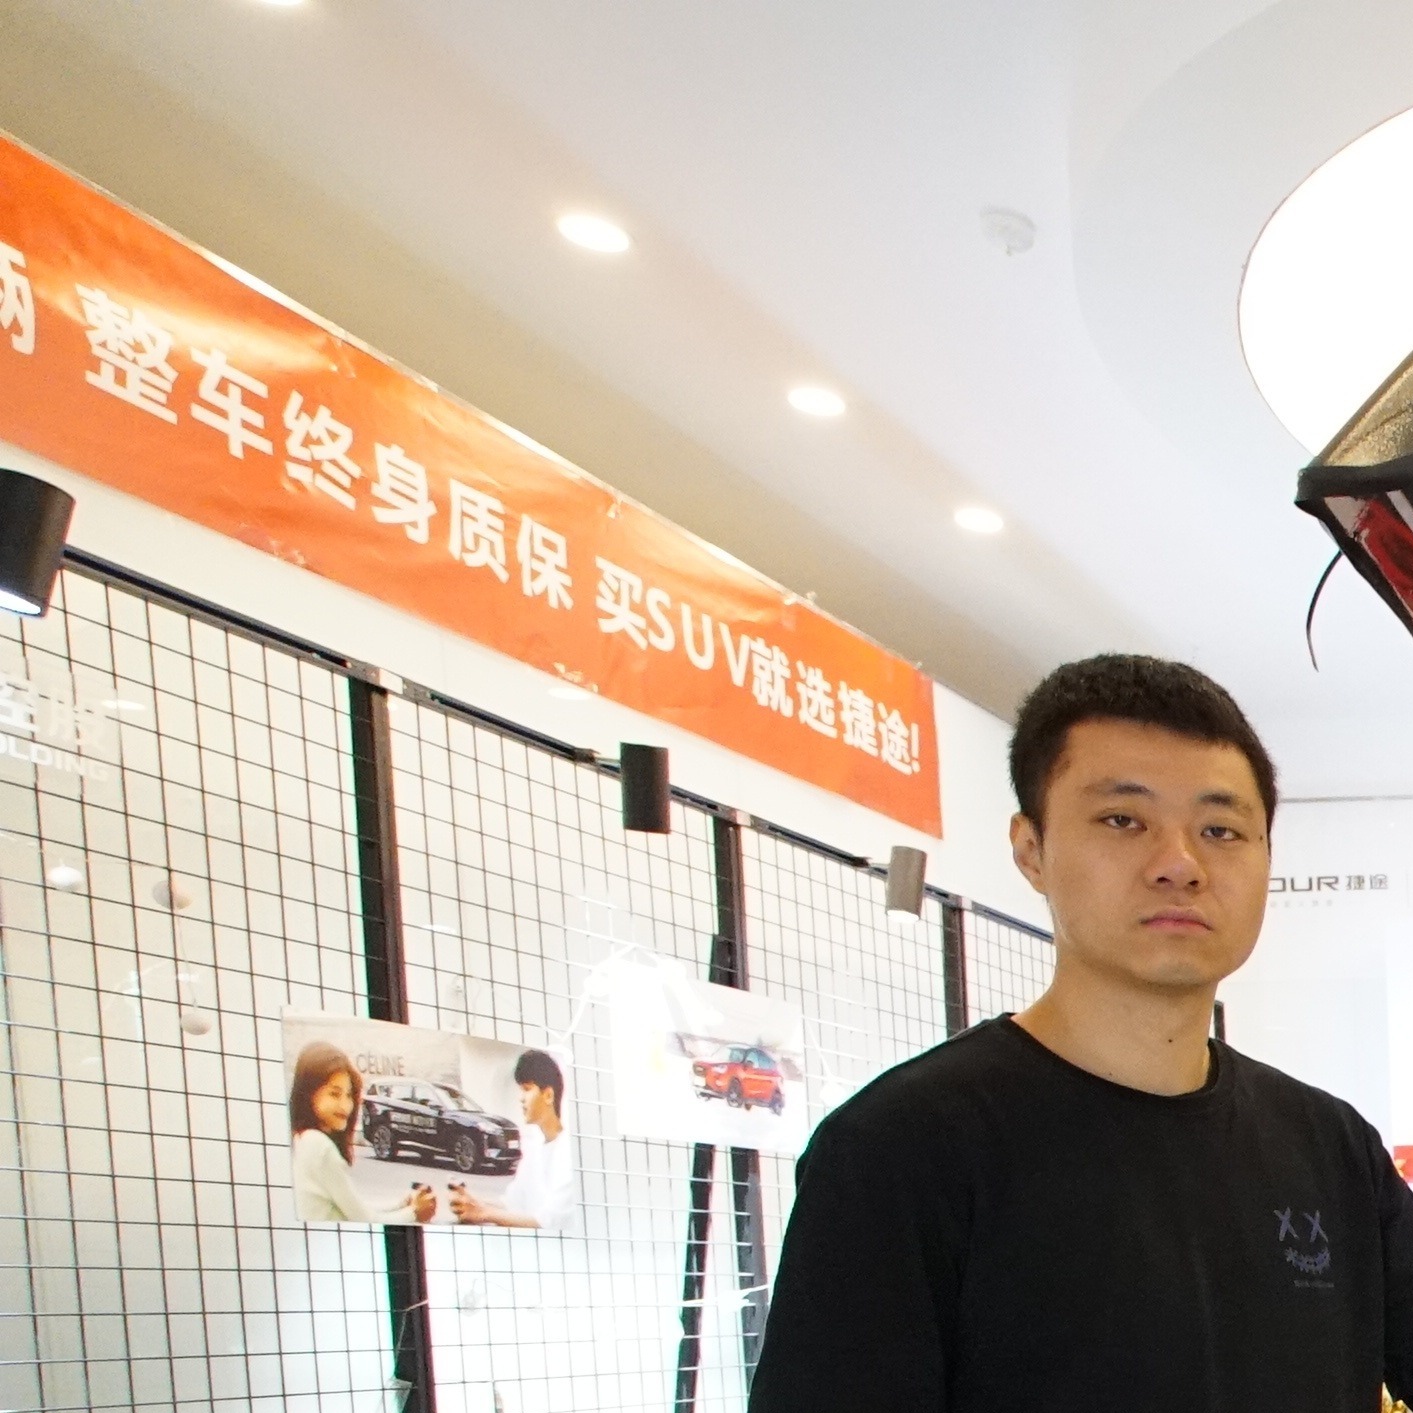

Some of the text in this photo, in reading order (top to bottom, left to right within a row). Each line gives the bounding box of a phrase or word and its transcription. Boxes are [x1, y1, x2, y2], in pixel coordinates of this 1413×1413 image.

[75, 283, 573, 609] 整车终身质保
[595, 555, 920, 775] 买SUV就选捷途!
[1346, 874, 1389, 891] 捷途
